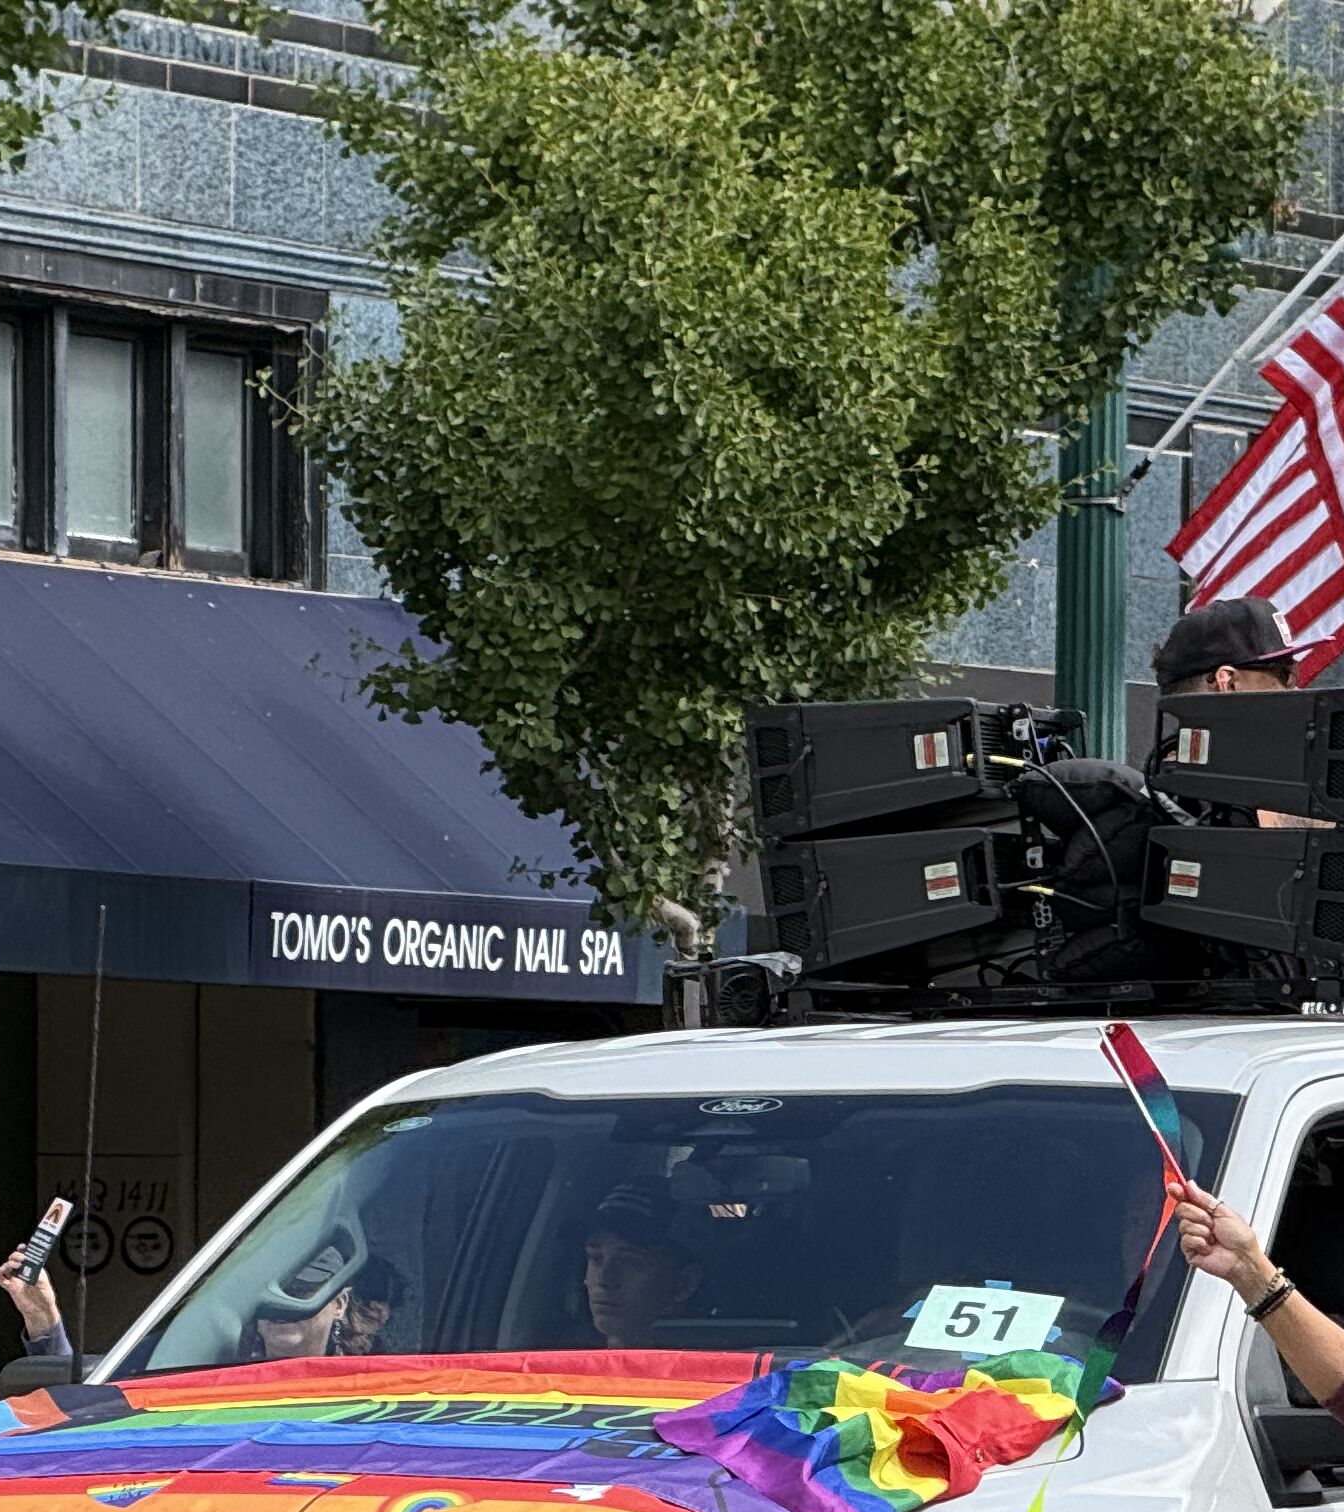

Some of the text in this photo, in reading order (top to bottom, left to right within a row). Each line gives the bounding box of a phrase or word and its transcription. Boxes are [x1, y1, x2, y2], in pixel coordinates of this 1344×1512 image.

[270, 911, 624, 976] TOMO'S ORGANIC NAIL SPA
[944, 1300, 1020, 1342] 51
